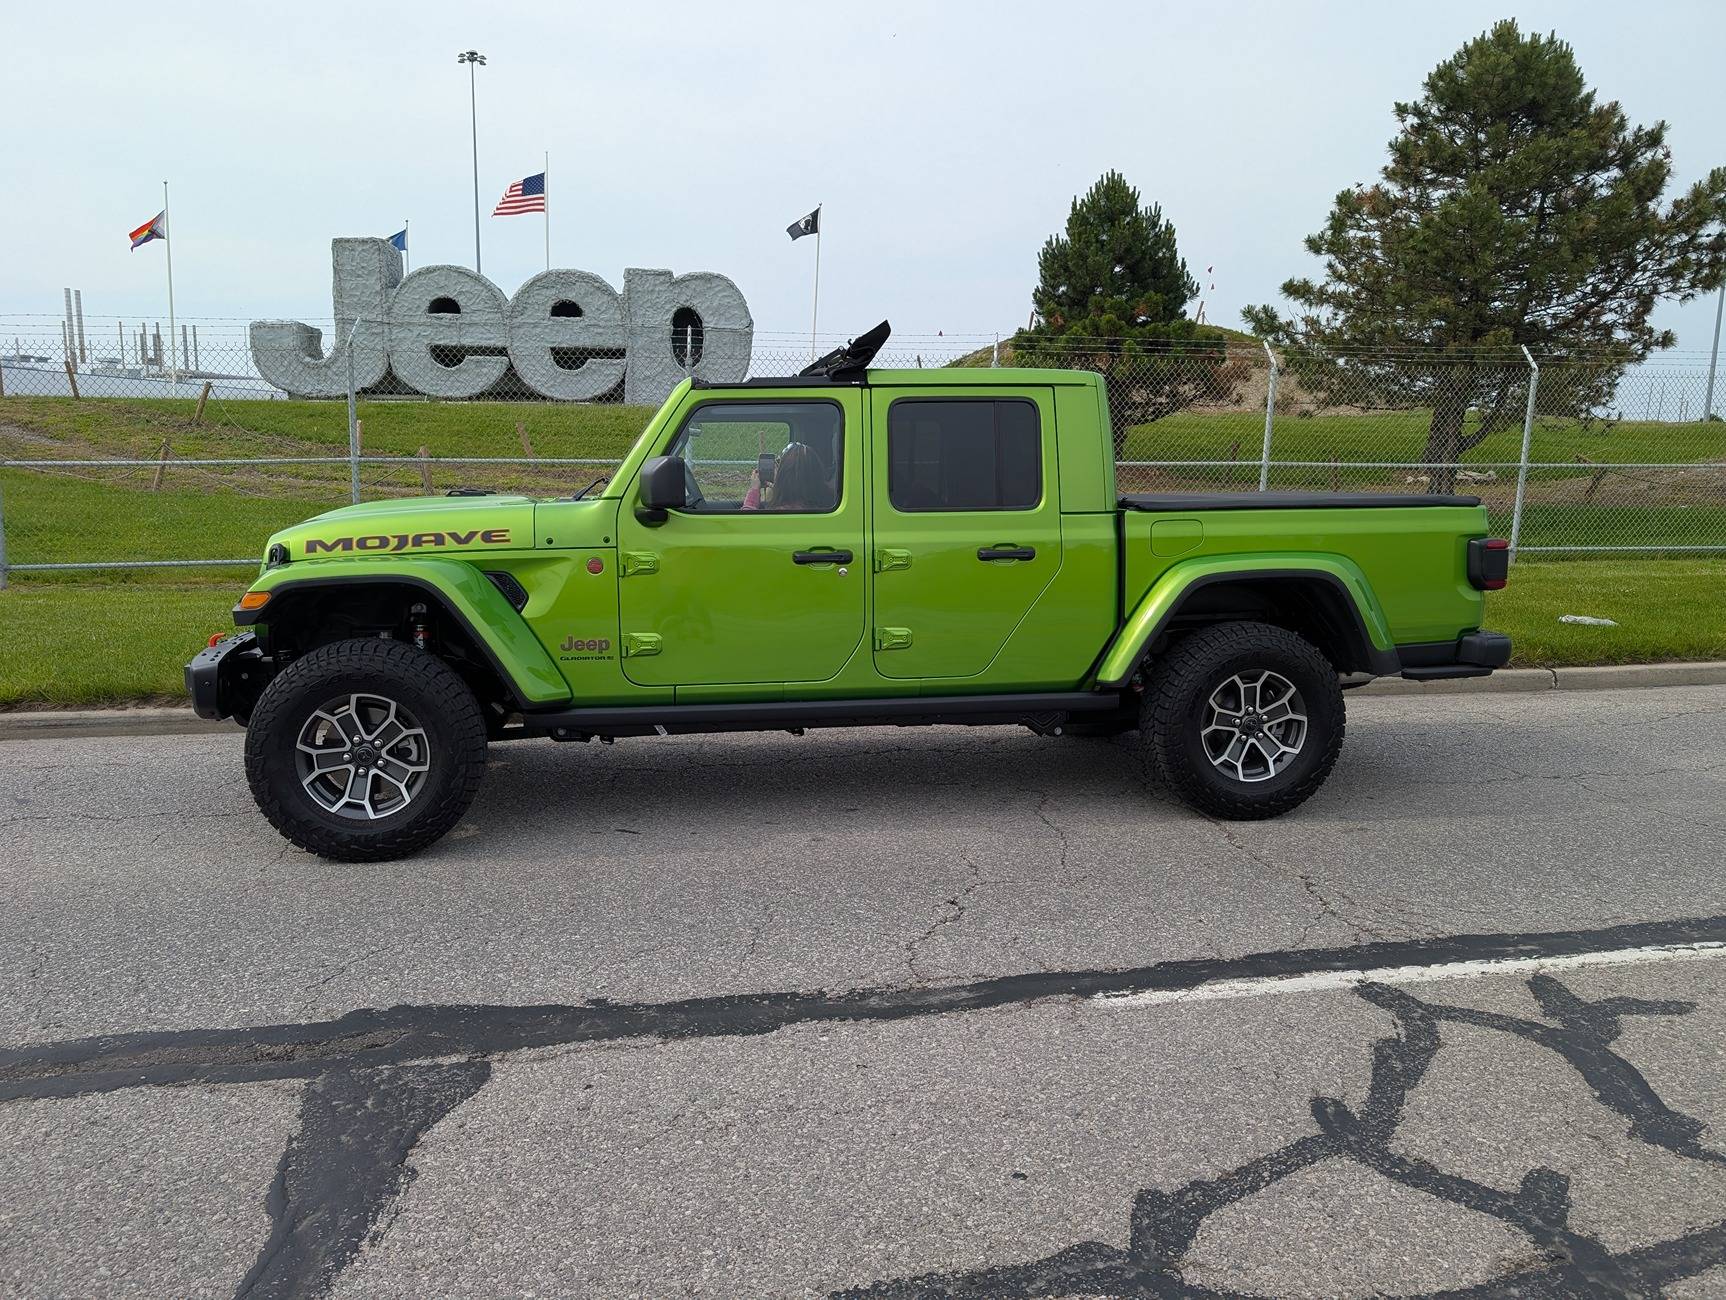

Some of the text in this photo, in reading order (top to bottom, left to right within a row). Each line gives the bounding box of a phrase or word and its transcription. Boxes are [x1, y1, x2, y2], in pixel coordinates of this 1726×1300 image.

[250, 237, 753, 404] Jeep
[304, 528, 511, 554] MOJAVE
[560, 636, 610, 654] Jeep
